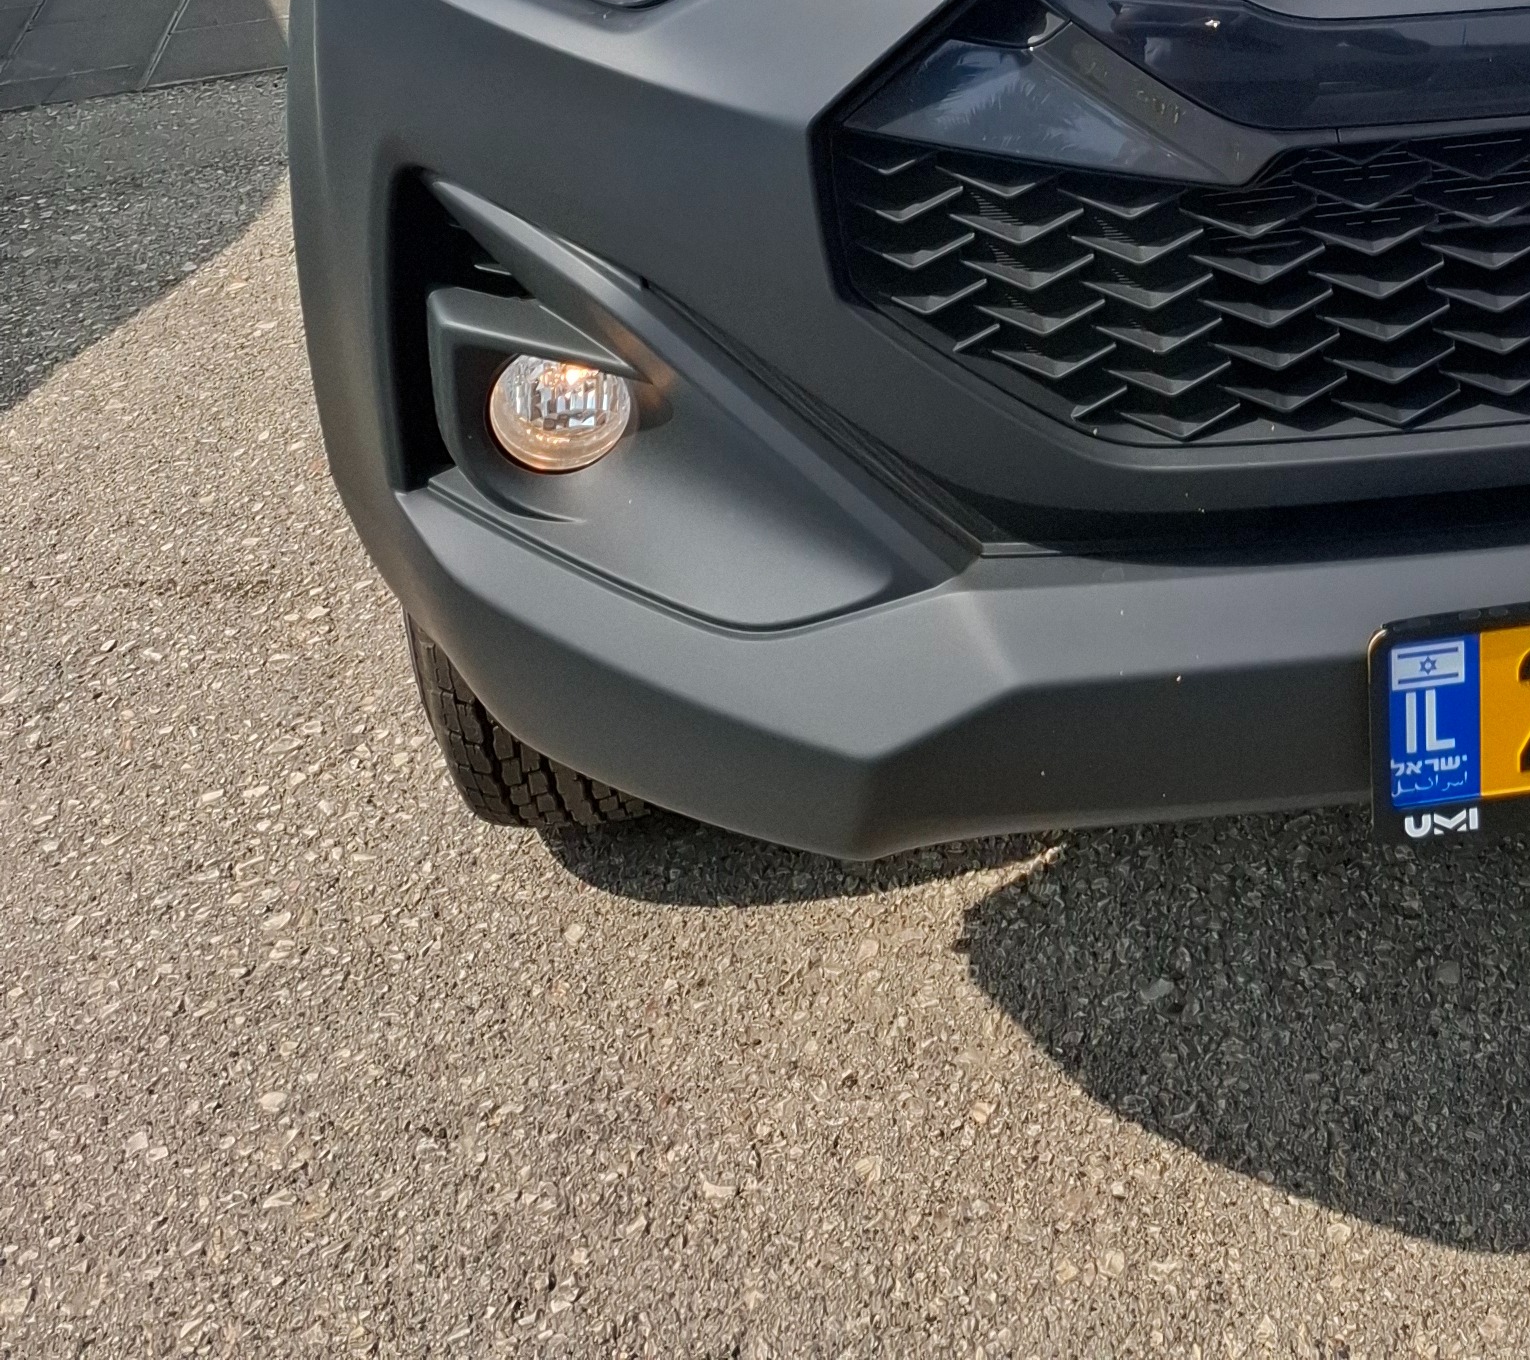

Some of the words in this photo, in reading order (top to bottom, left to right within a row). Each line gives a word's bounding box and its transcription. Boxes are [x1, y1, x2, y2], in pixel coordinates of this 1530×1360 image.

[1405, 688, 1456, 754] IL
[1390, 754, 1468, 777] ישראל
[1404, 806, 1479, 838] UMI
